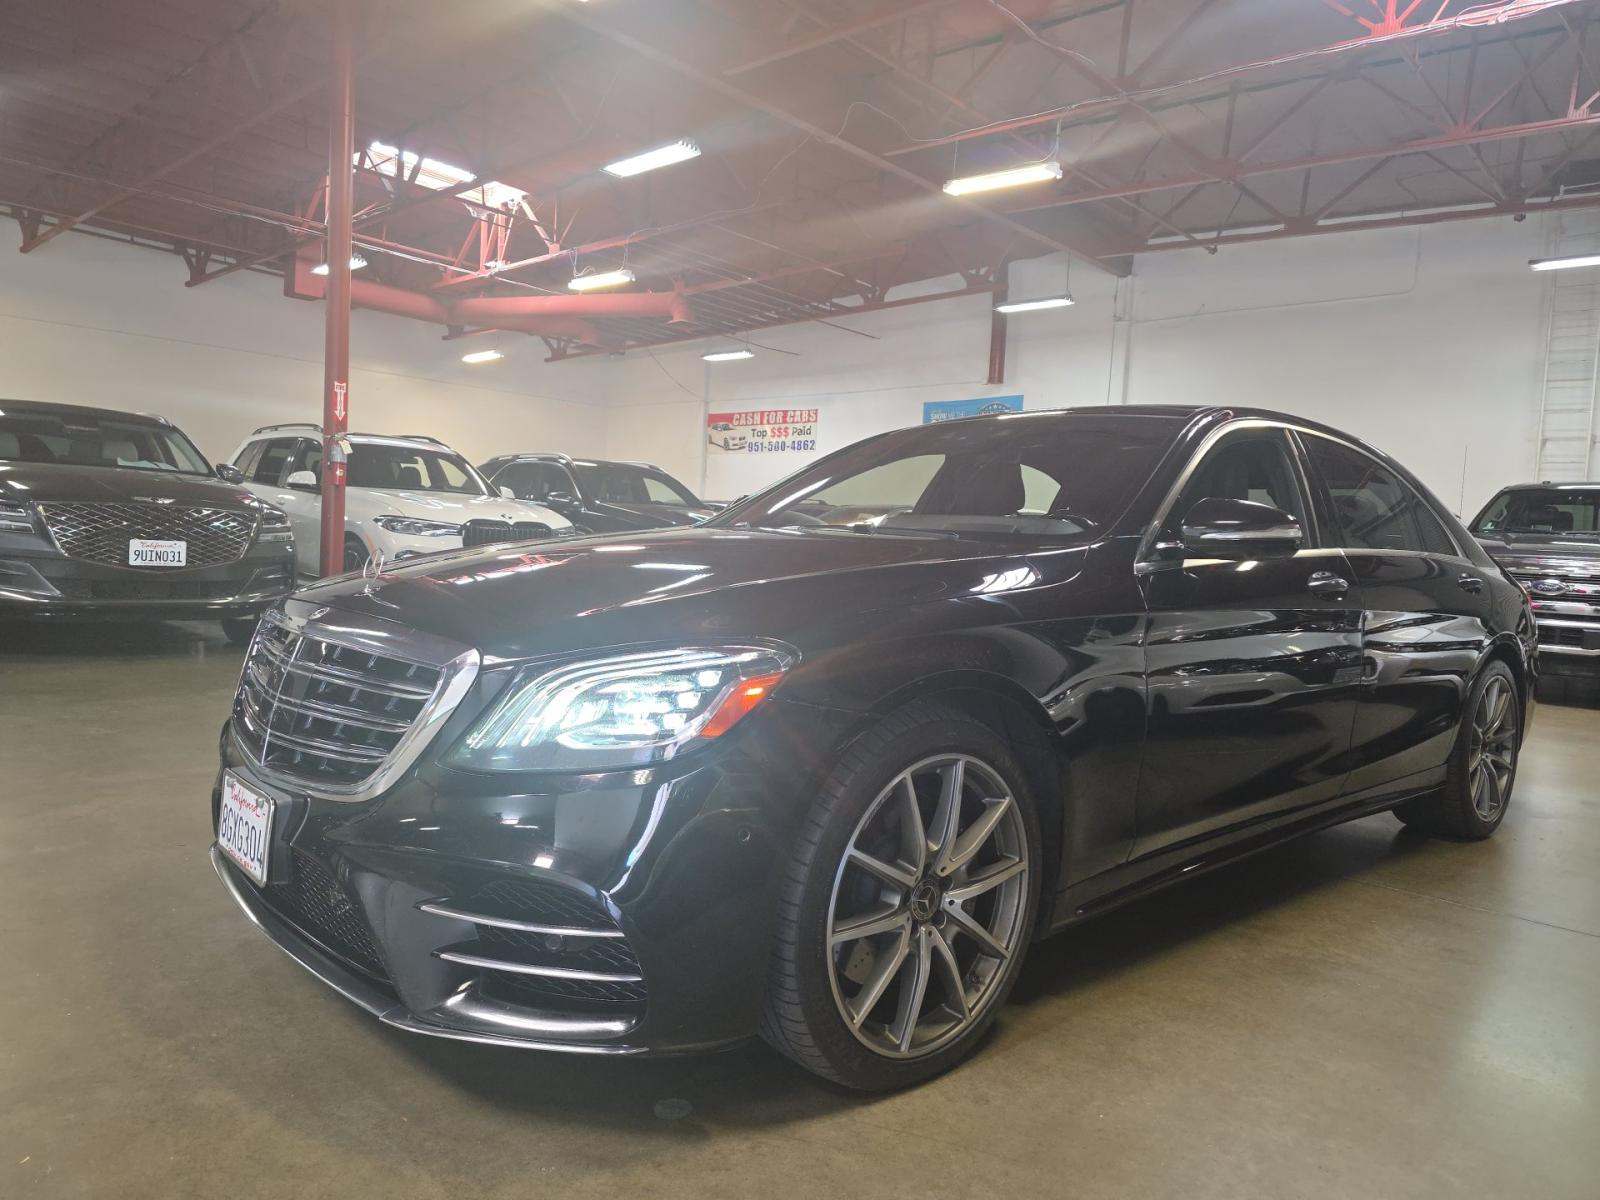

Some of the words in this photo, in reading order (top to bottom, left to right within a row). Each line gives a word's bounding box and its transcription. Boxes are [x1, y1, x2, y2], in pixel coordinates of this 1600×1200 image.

[733, 412, 761, 426] CASH
[764, 411, 783, 425] FOR
[786, 410, 817, 424] CARS
[751, 428, 767, 439] Top
[770, 427, 790, 438] $$$
[792, 425, 812, 436] Paid
[133, 549, 182, 563] 9UIN031
[221, 803, 263, 868] 8GXG304
